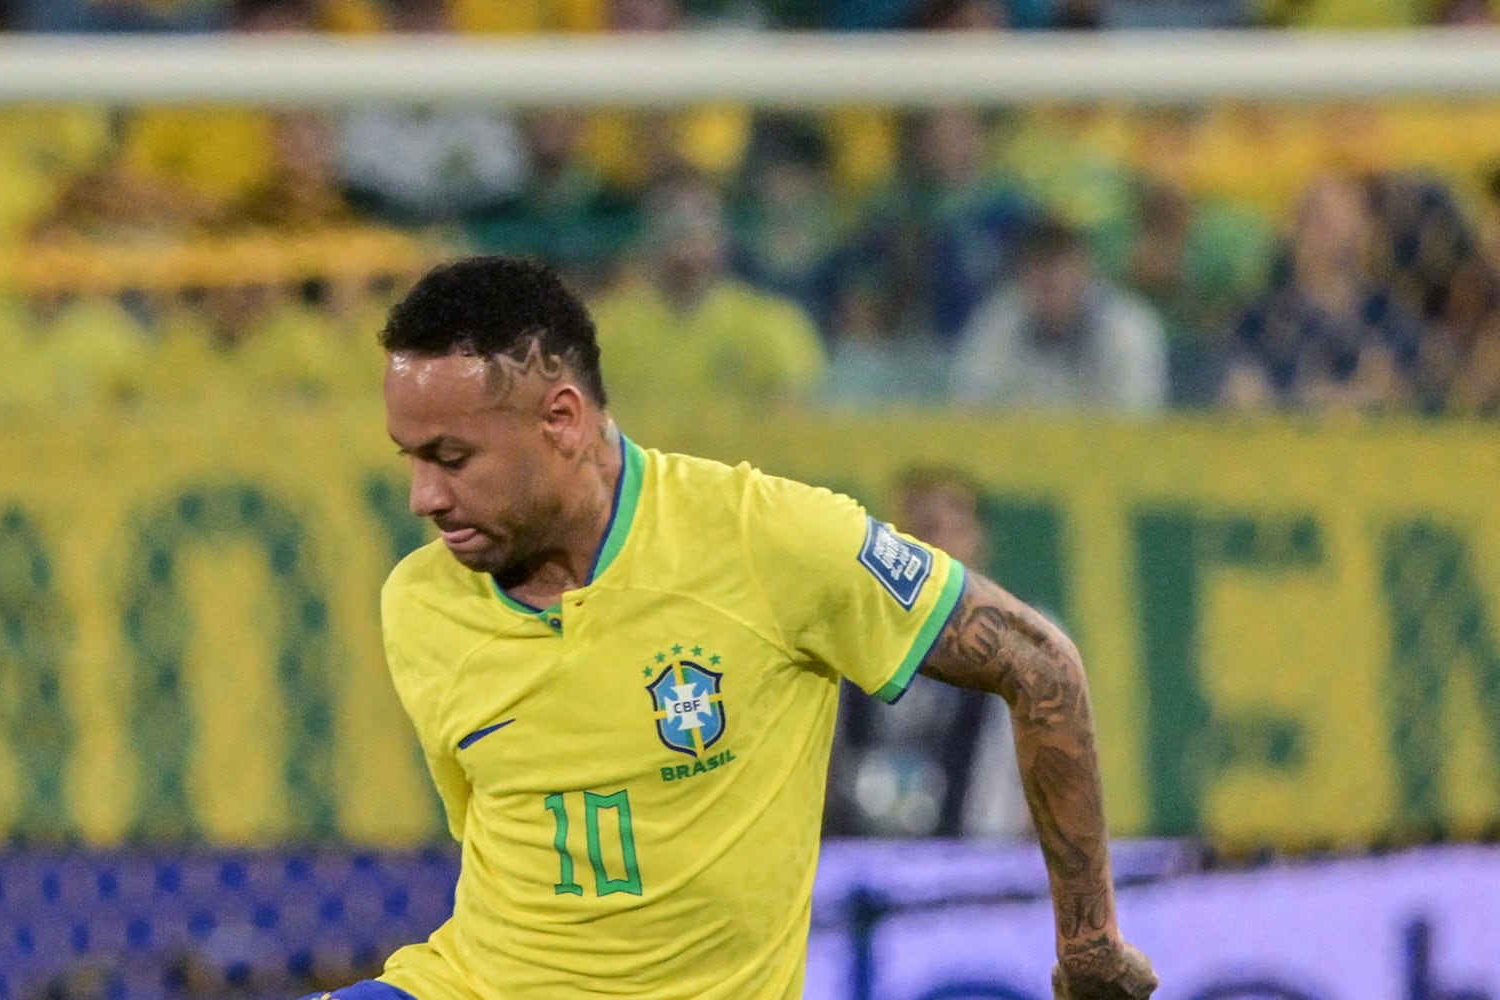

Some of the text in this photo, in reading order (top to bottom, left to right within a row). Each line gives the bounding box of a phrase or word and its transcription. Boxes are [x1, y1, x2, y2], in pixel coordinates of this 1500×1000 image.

[672, 699, 702, 715] CBF
[660, 750, 736, 782] BRASIL
[544, 789, 643, 897] 10
